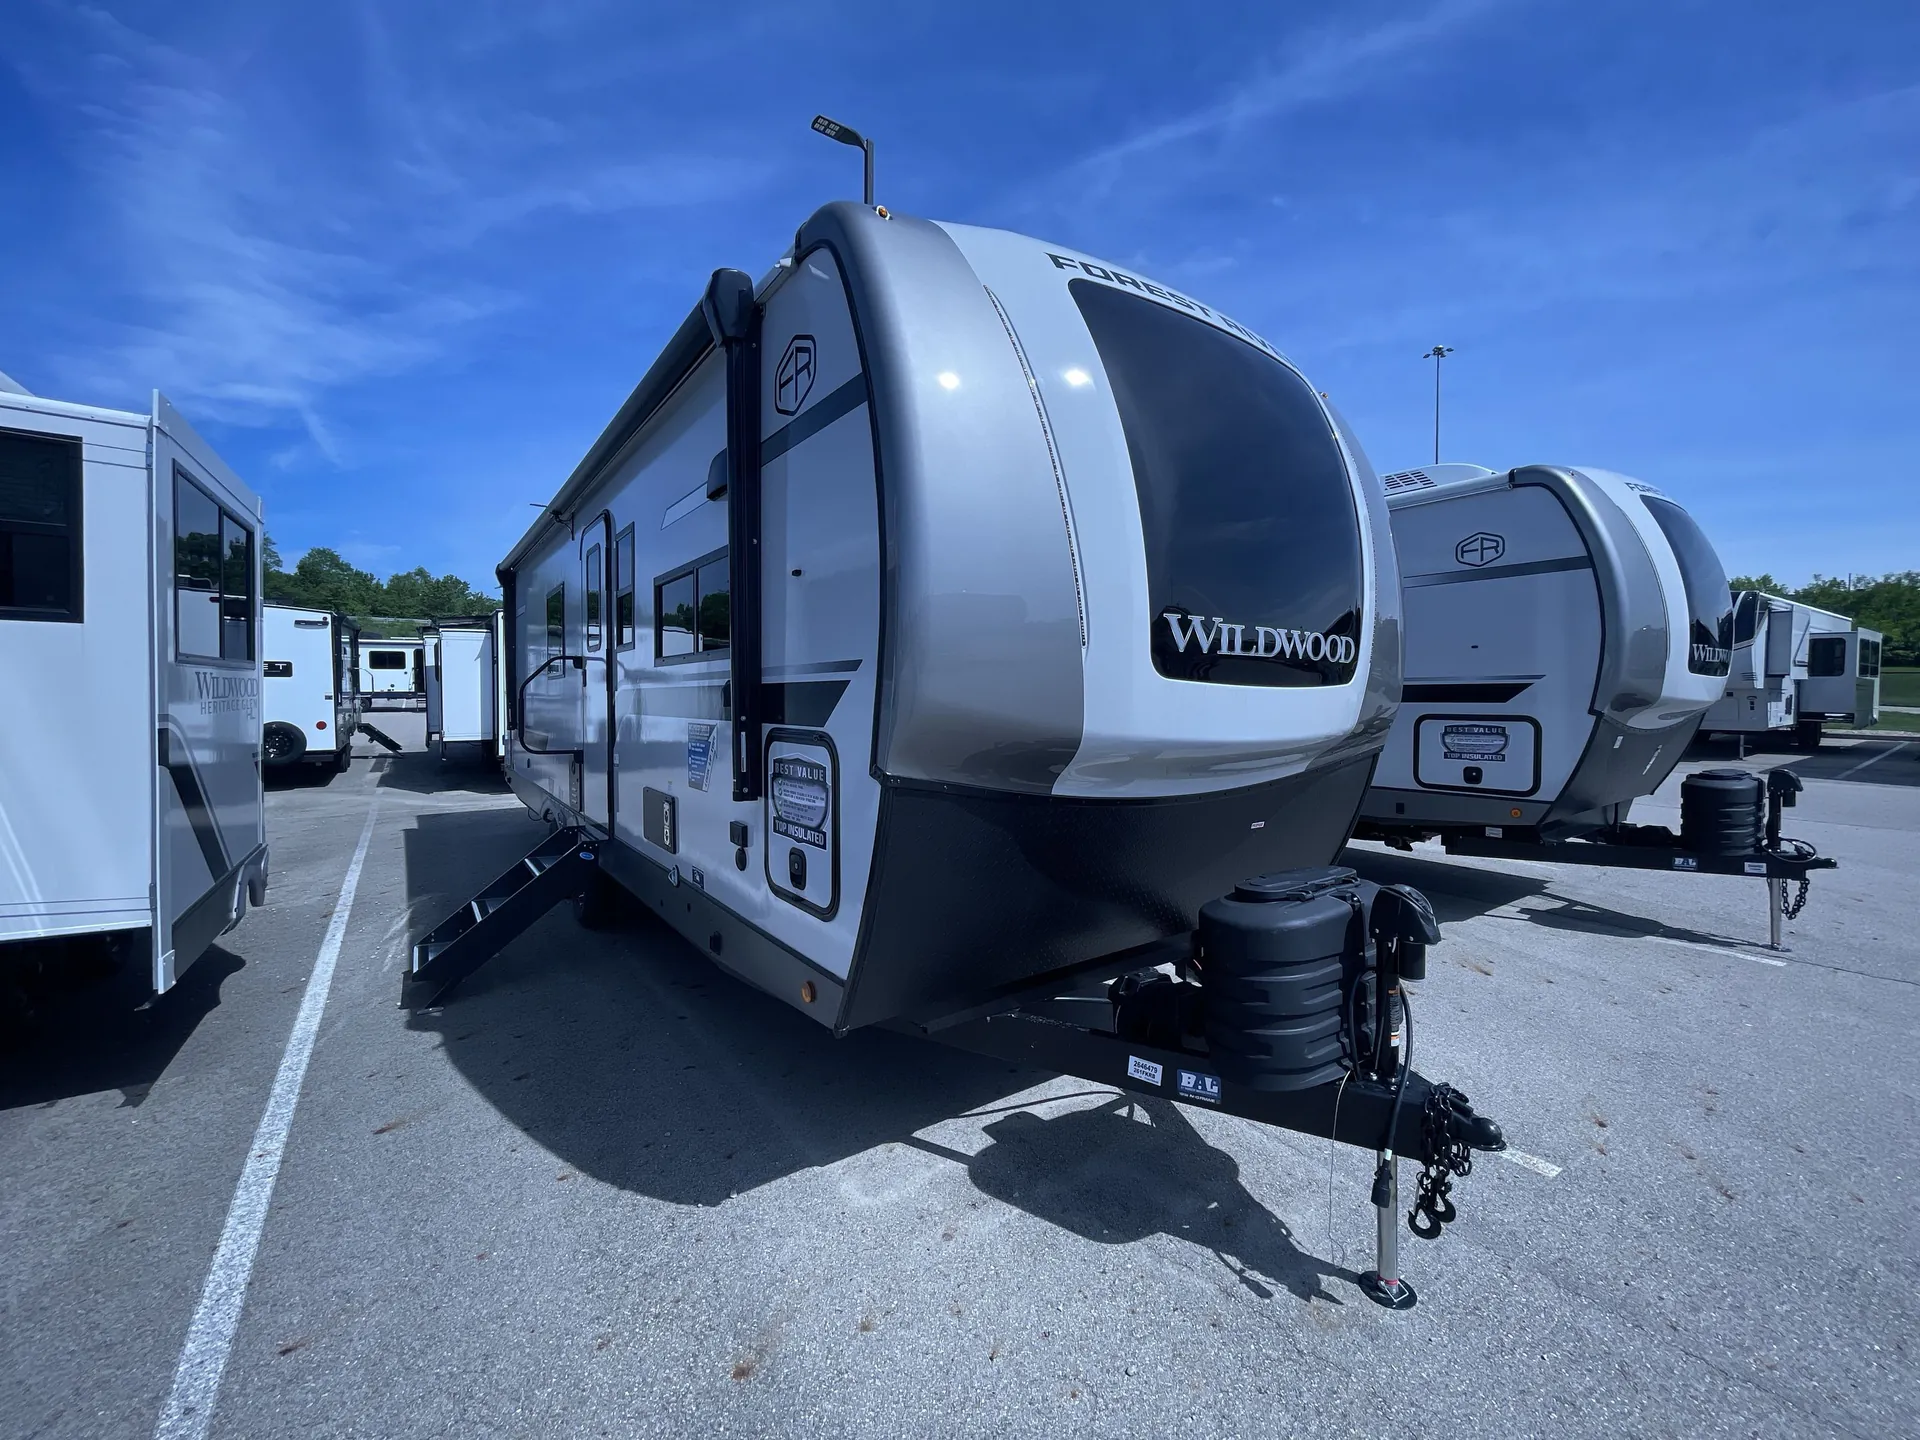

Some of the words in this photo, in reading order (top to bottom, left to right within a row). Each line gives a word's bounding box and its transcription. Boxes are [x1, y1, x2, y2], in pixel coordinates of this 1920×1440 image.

[1044, 252, 1212, 318] FOREST
[1163, 613, 1356, 664] WILDWOOD
[195, 671, 258, 700] WILDWOOD
[200, 700, 240, 715] HERITAGE
[774, 762, 794, 776] BEST
[797, 766, 824, 781] VALUE
[775, 820, 787, 833] TOP
[787, 823, 824, 846] INSULATED
[1181, 1072, 1219, 1094] BAL
